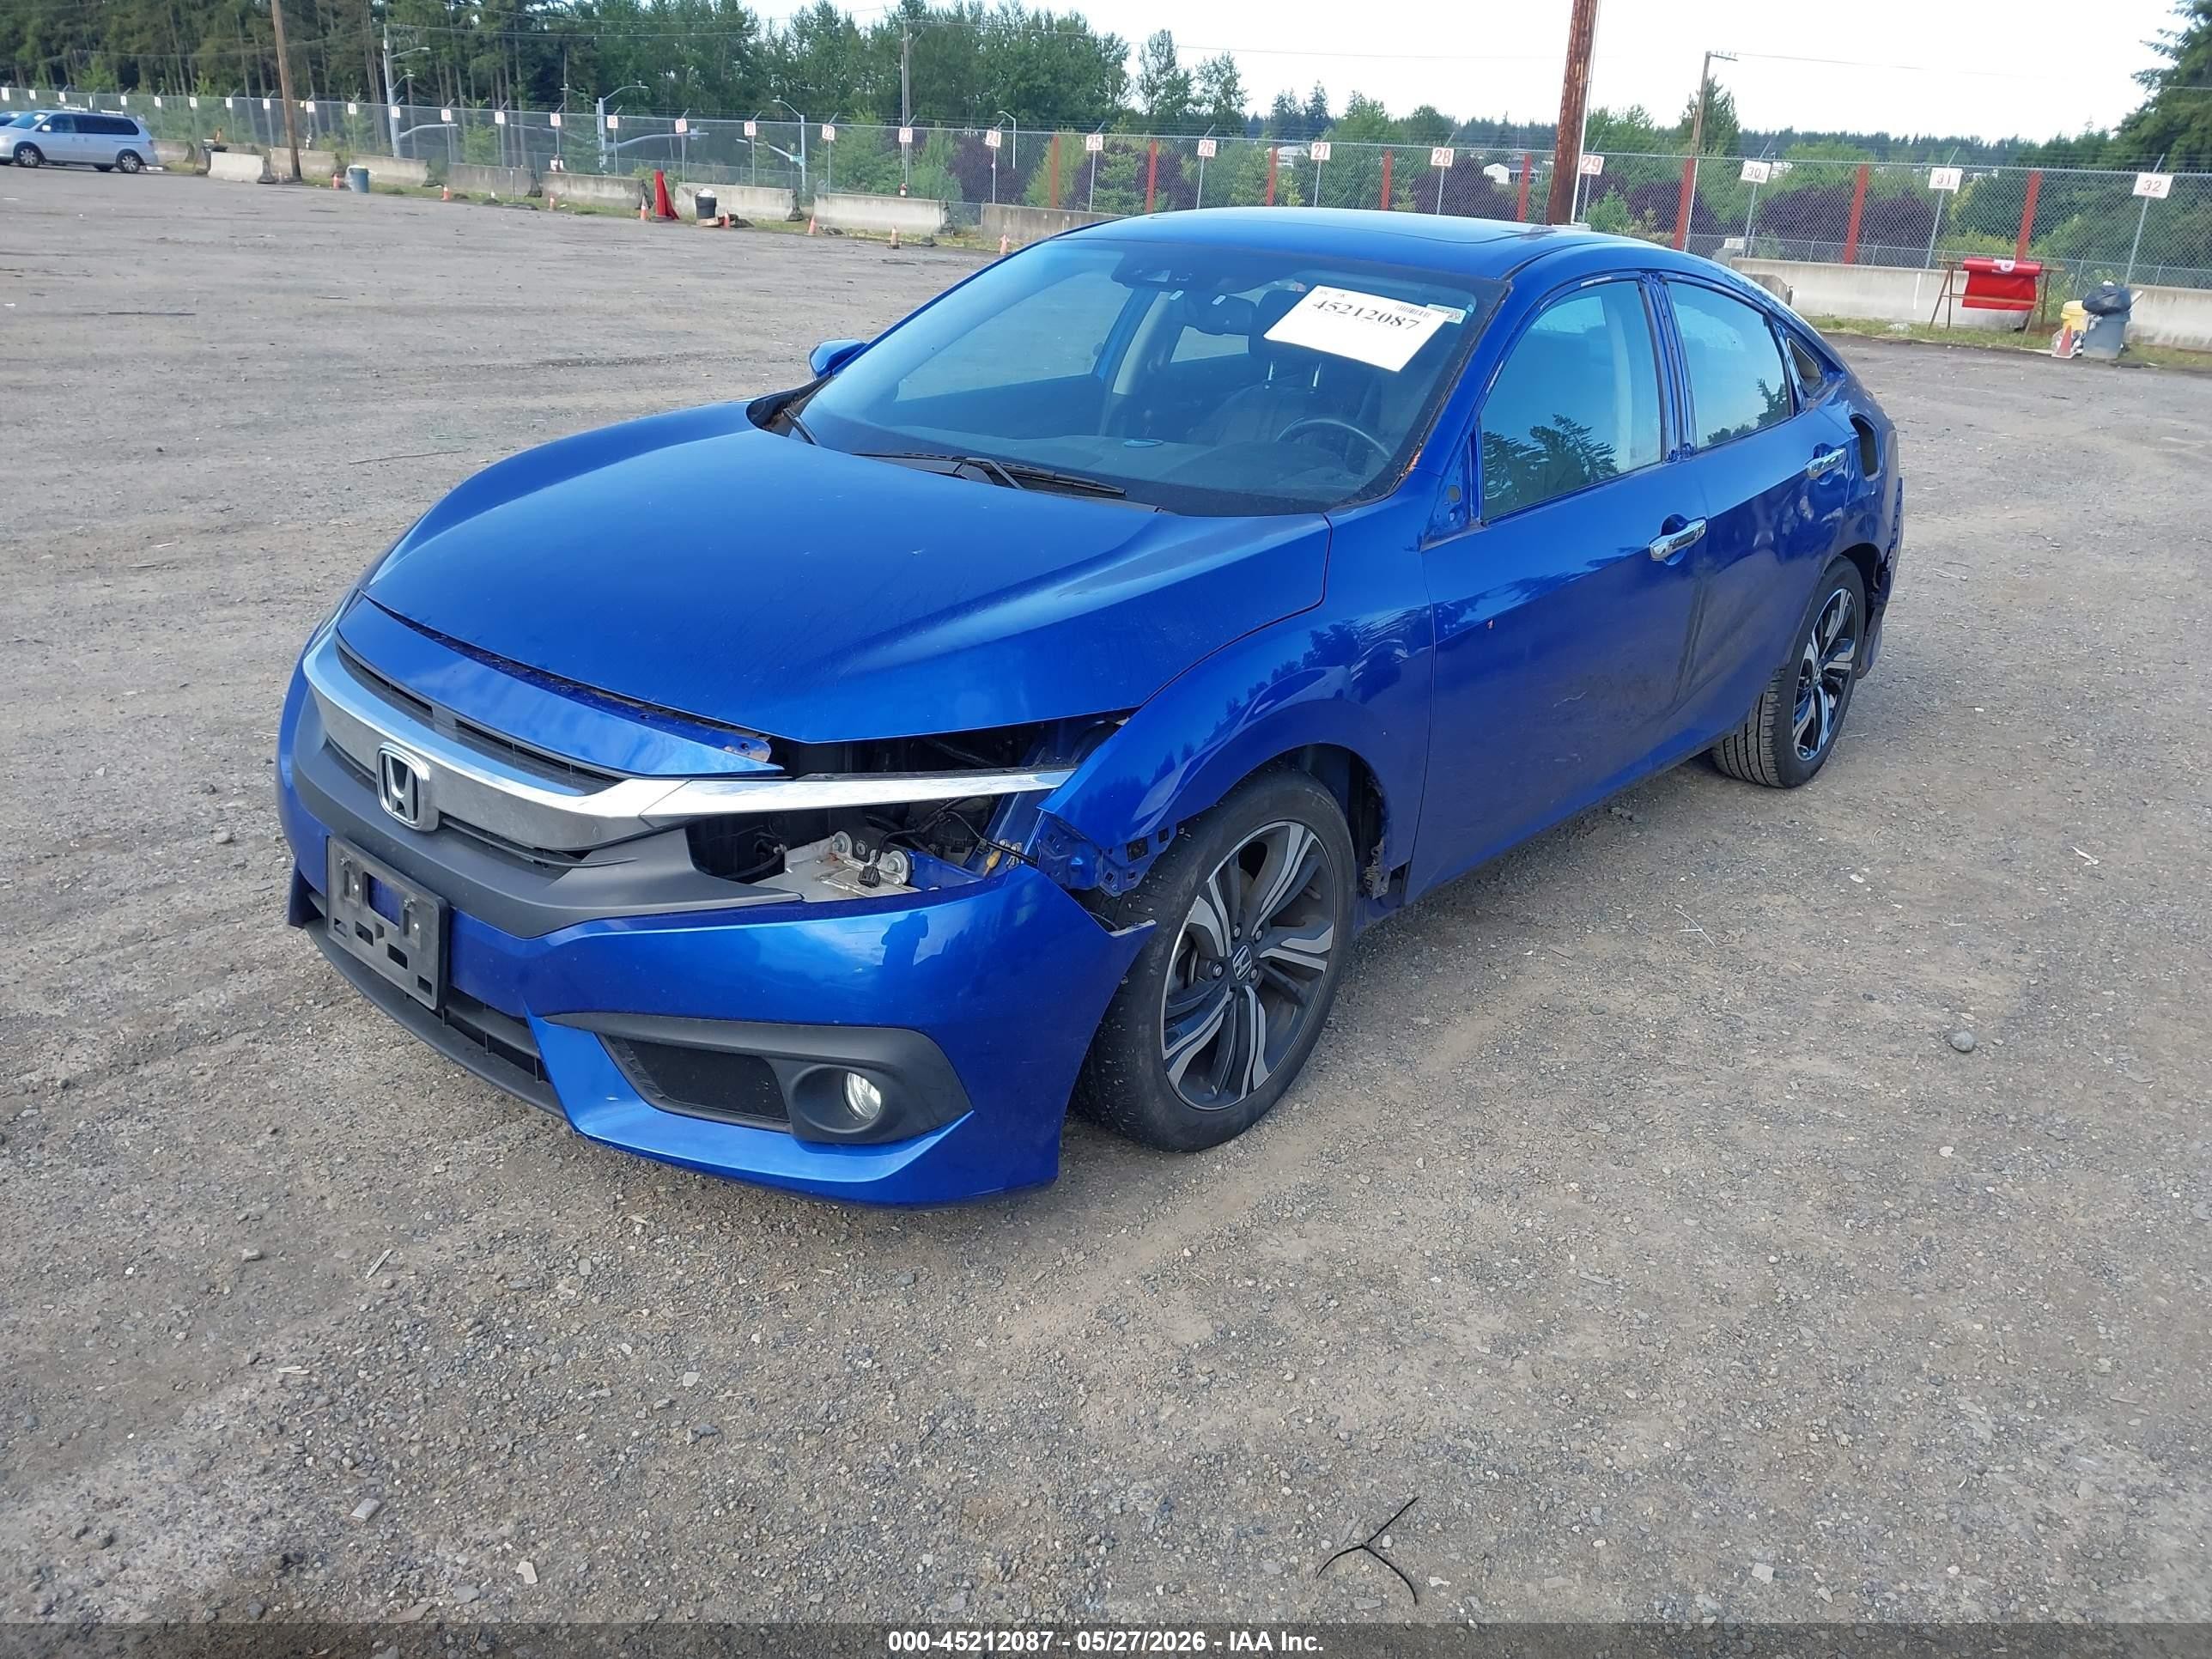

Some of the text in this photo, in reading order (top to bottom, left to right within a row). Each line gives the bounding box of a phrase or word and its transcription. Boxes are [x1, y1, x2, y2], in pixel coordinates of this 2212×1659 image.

[609, 116, 617, 127] 19
[677, 119, 685, 131] 20
[746, 123, 754, 135] 21
[824, 125, 834, 138] 22
[901, 129, 910, 141] 23
[988, 131, 999, 145] 24
[1088, 135, 1101, 149] 25
[1200, 141, 1213, 155] 26
[1314, 143, 1328, 159] 27
[1434, 149, 1451, 165] 28
[1582, 156, 1601, 173] 29
[1747, 167, 1761, 179] 30
[1937, 173, 1951, 185] 31
[2143, 179, 2162, 192] 32
[1313, 300, 1419, 330] 45212087
